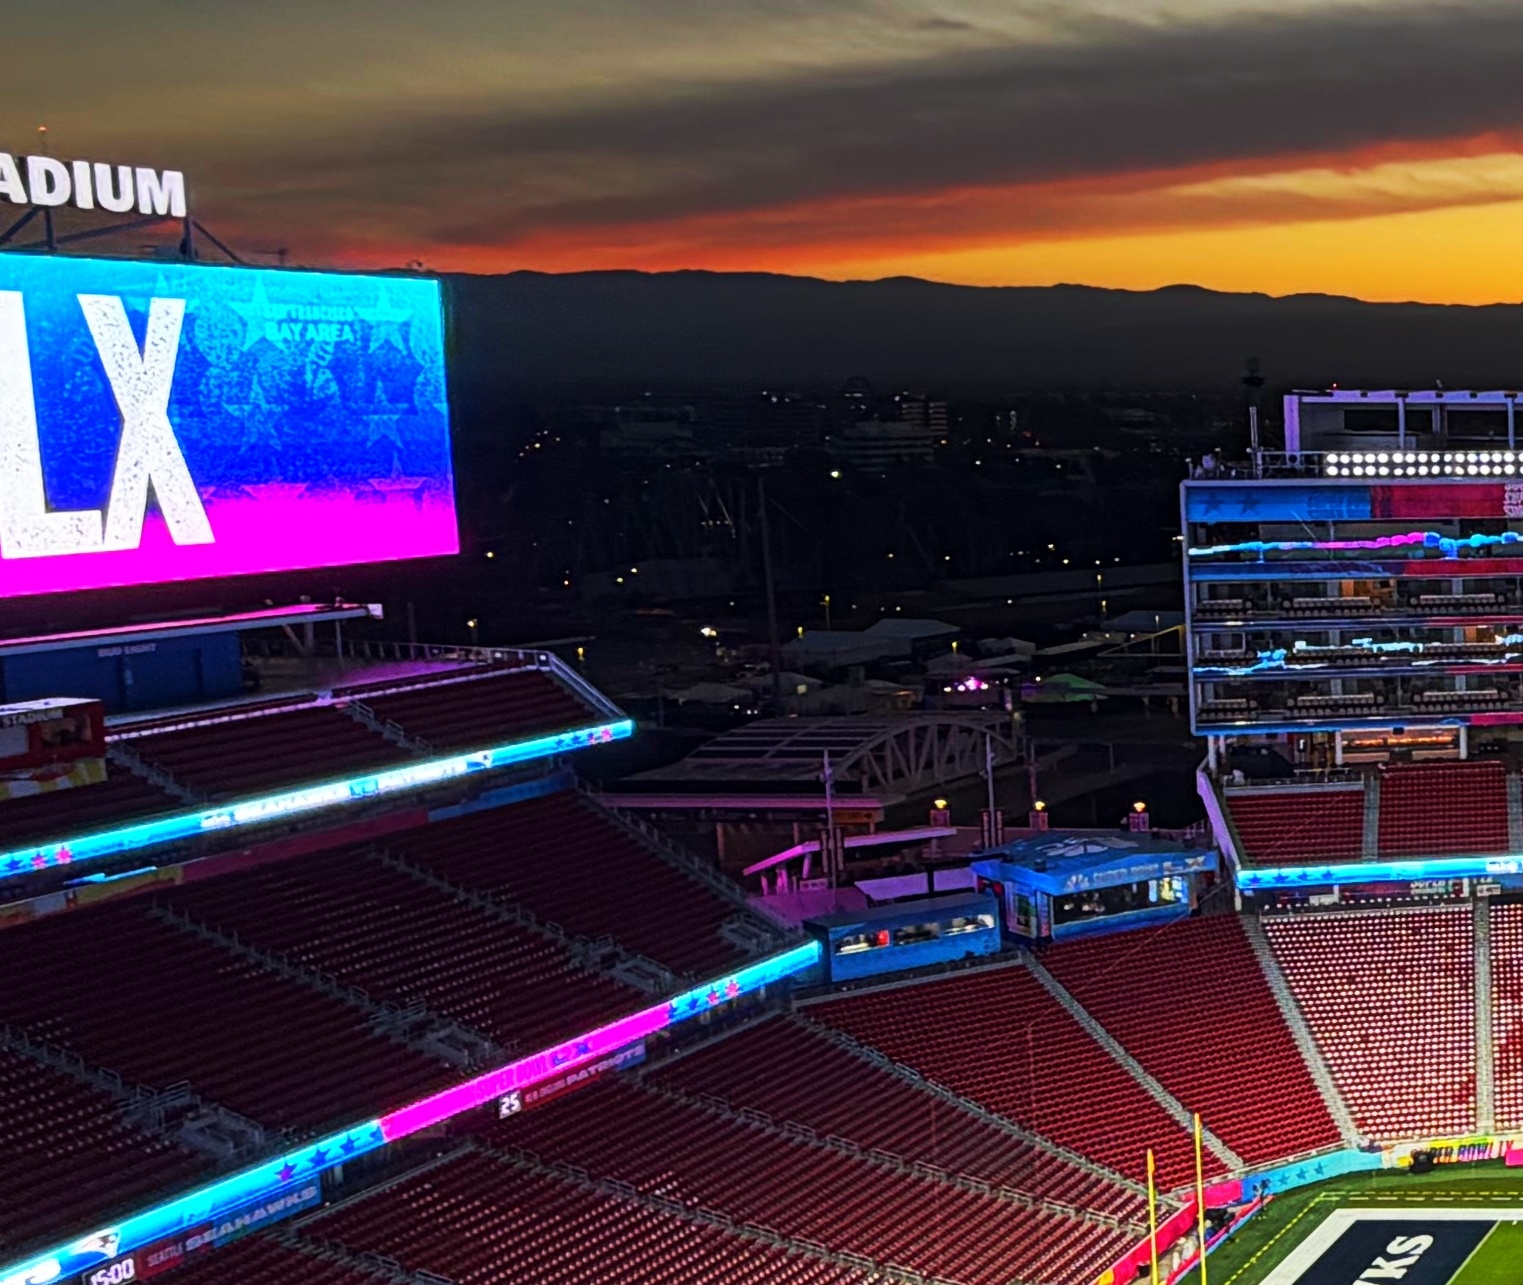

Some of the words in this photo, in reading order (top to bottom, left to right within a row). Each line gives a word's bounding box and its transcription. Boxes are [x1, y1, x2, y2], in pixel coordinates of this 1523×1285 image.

[264, 322, 302, 341] BAY
[500, 1092, 522, 1115] 25
[185, 1185, 319, 1252] SEAHAWKS
